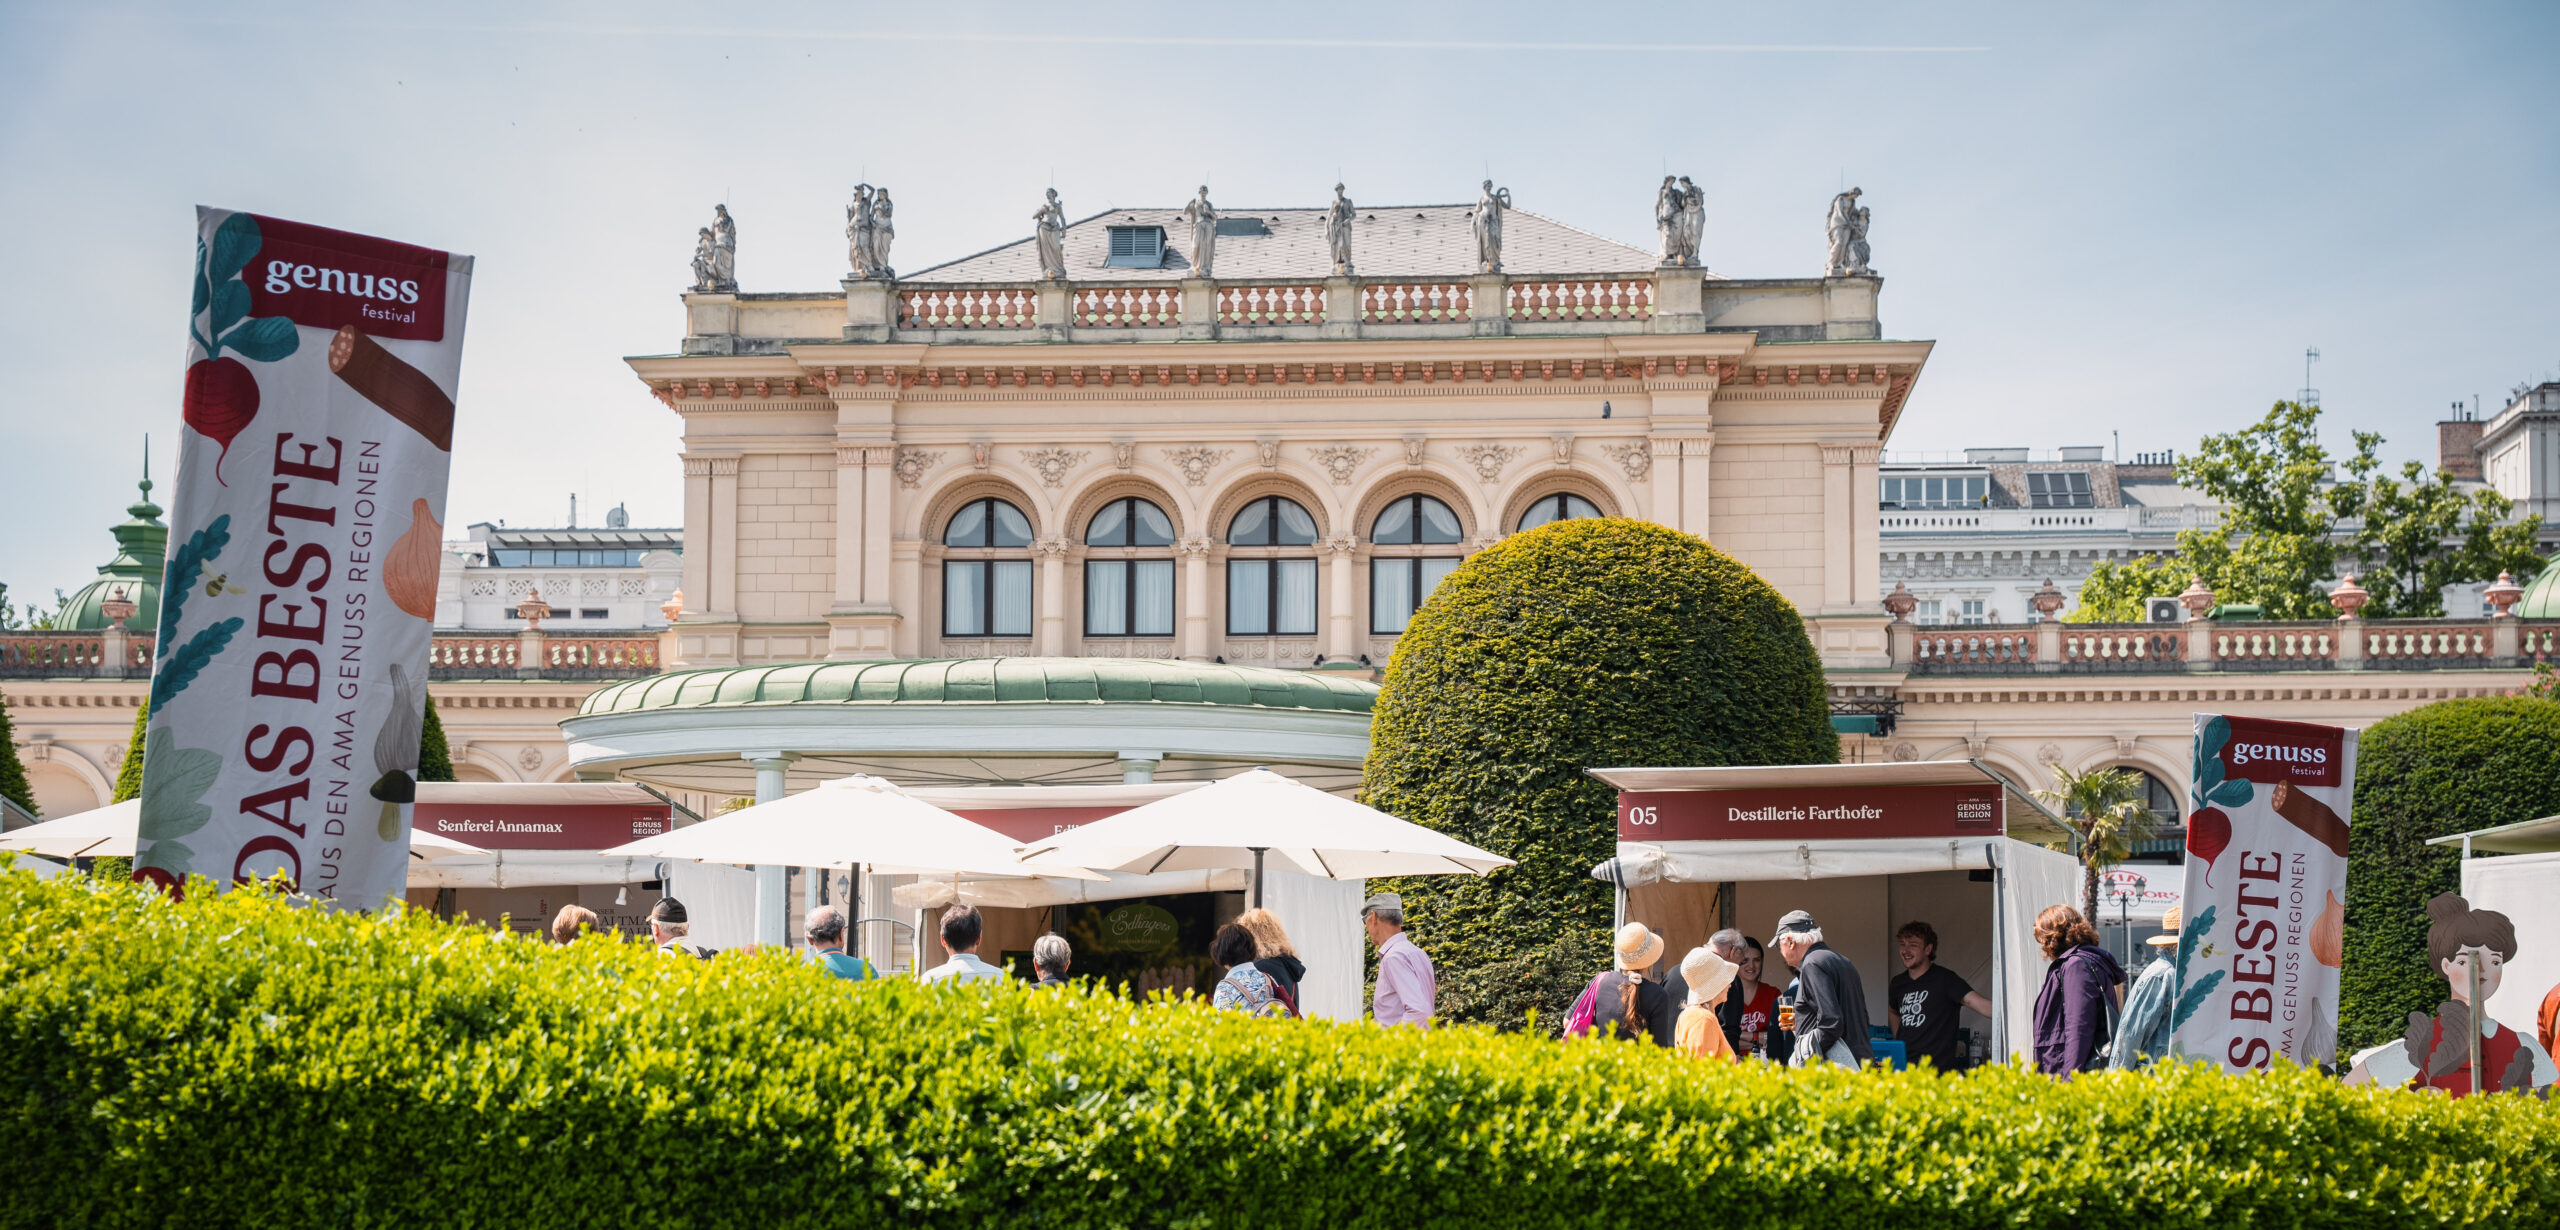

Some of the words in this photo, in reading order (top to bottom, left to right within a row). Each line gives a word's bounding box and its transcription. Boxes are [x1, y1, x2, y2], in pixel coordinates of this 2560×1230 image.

[264, 260, 419, 304] genuss
[361, 303, 415, 323] festival
[348, 440, 381, 582] REGIONEN
[251, 432, 343, 704] BESTE
[337, 593, 367, 700] GENUSS
[331, 710, 356, 771] AMA
[2232, 742, 2327, 765] genuss
[2291, 765, 2325, 776] festival
[232, 723, 314, 895] DAS
[324, 780, 350, 836] DEN
[437, 819, 494, 832] Senferei
[496, 819, 563, 833] Annamax
[1629, 806, 1658, 826] 05
[1728, 805, 1806, 822] Destillerie
[1809, 805, 1883, 821] Farthofer
[1957, 803, 1992, 811] GENUSS
[317, 847, 342, 899] AUS
[2287, 853, 2306, 946] REGIONEN
[1110, 910, 1171, 936] Edlingers
[2230, 850, 2282, 1024] BESTE
[1902, 990, 1929, 1004] HELD
[2283, 952, 2300, 1022] GENUSS
[1901, 1013, 1926, 1027] FELD
[2281, 1027, 2294, 1057] MA
